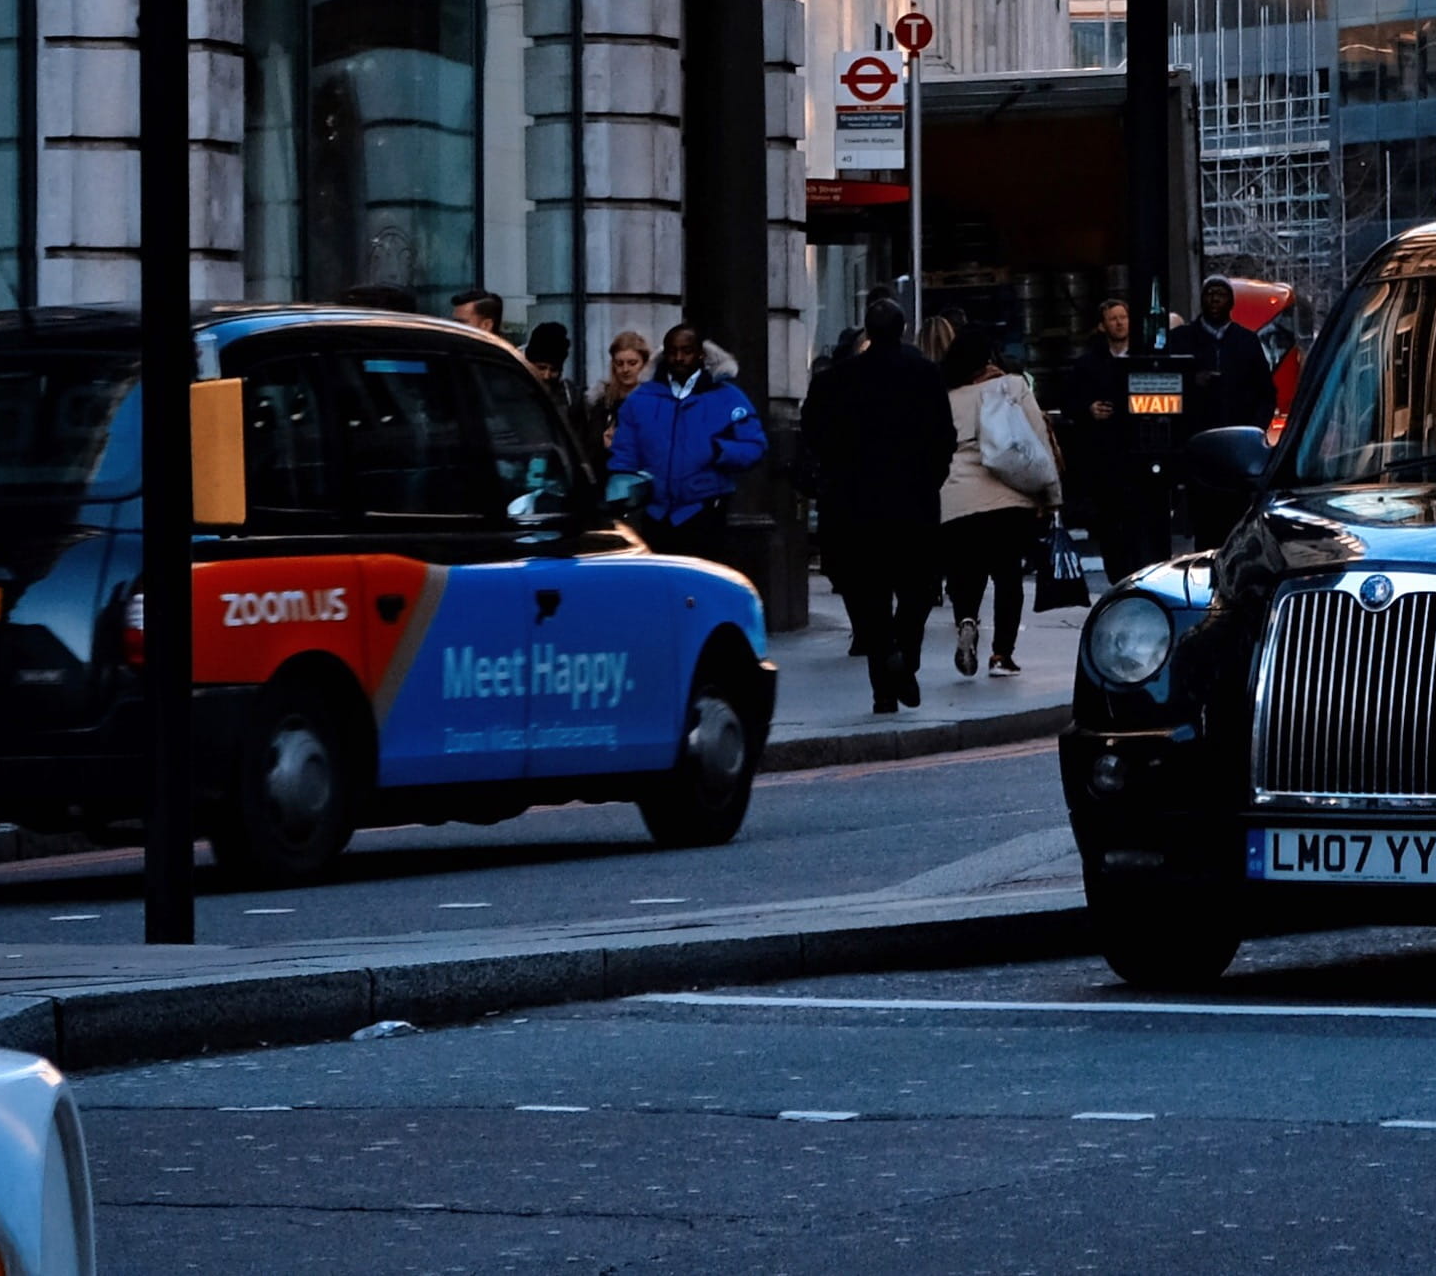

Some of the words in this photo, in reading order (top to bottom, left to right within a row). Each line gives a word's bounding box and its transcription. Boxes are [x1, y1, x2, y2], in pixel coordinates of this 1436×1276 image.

[904, 18, 925, 46] T
[1130, 395, 1181, 414] WAIT
[219, 587, 349, 628] zoom.us
[442, 646, 527, 700] Meet
[530, 643, 635, 709] Happy.
[1272, 832, 1373, 874] LM07
